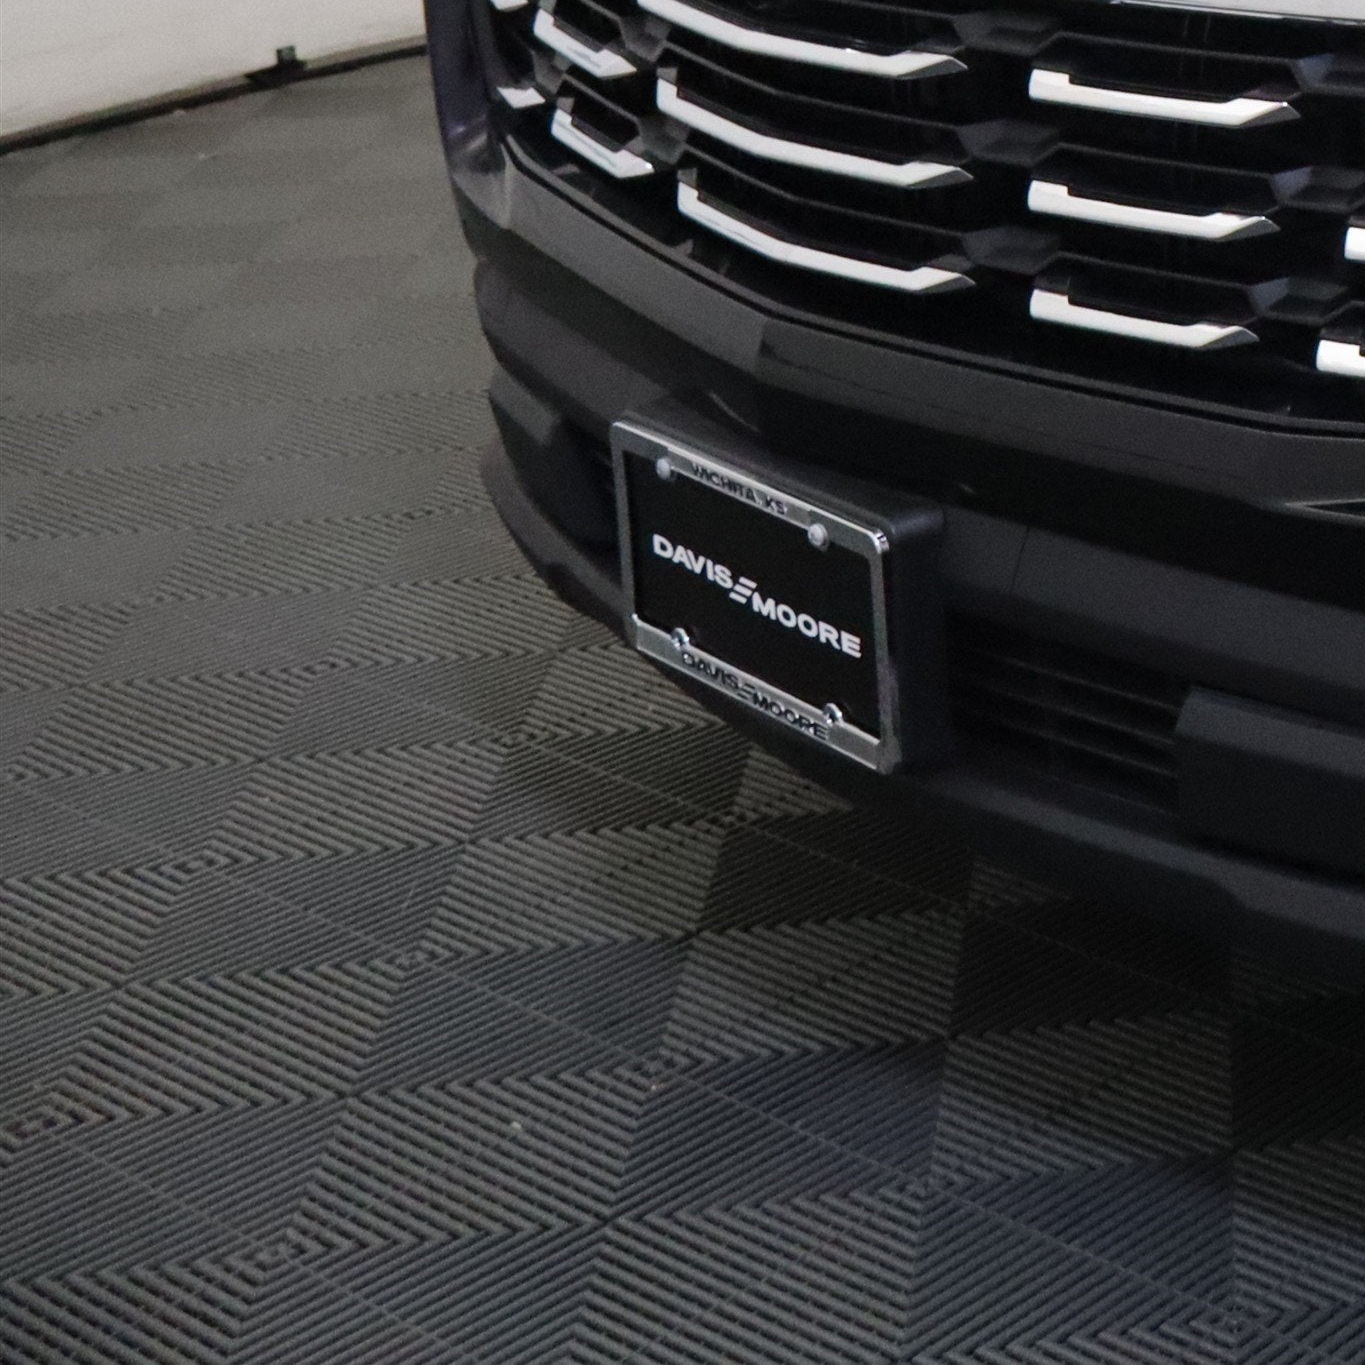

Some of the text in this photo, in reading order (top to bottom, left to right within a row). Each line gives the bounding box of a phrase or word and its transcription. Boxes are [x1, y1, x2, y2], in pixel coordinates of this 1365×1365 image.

[652, 533, 862, 659] DAVIS MOORE
[681, 652, 828, 741] DAVIS MOORE
